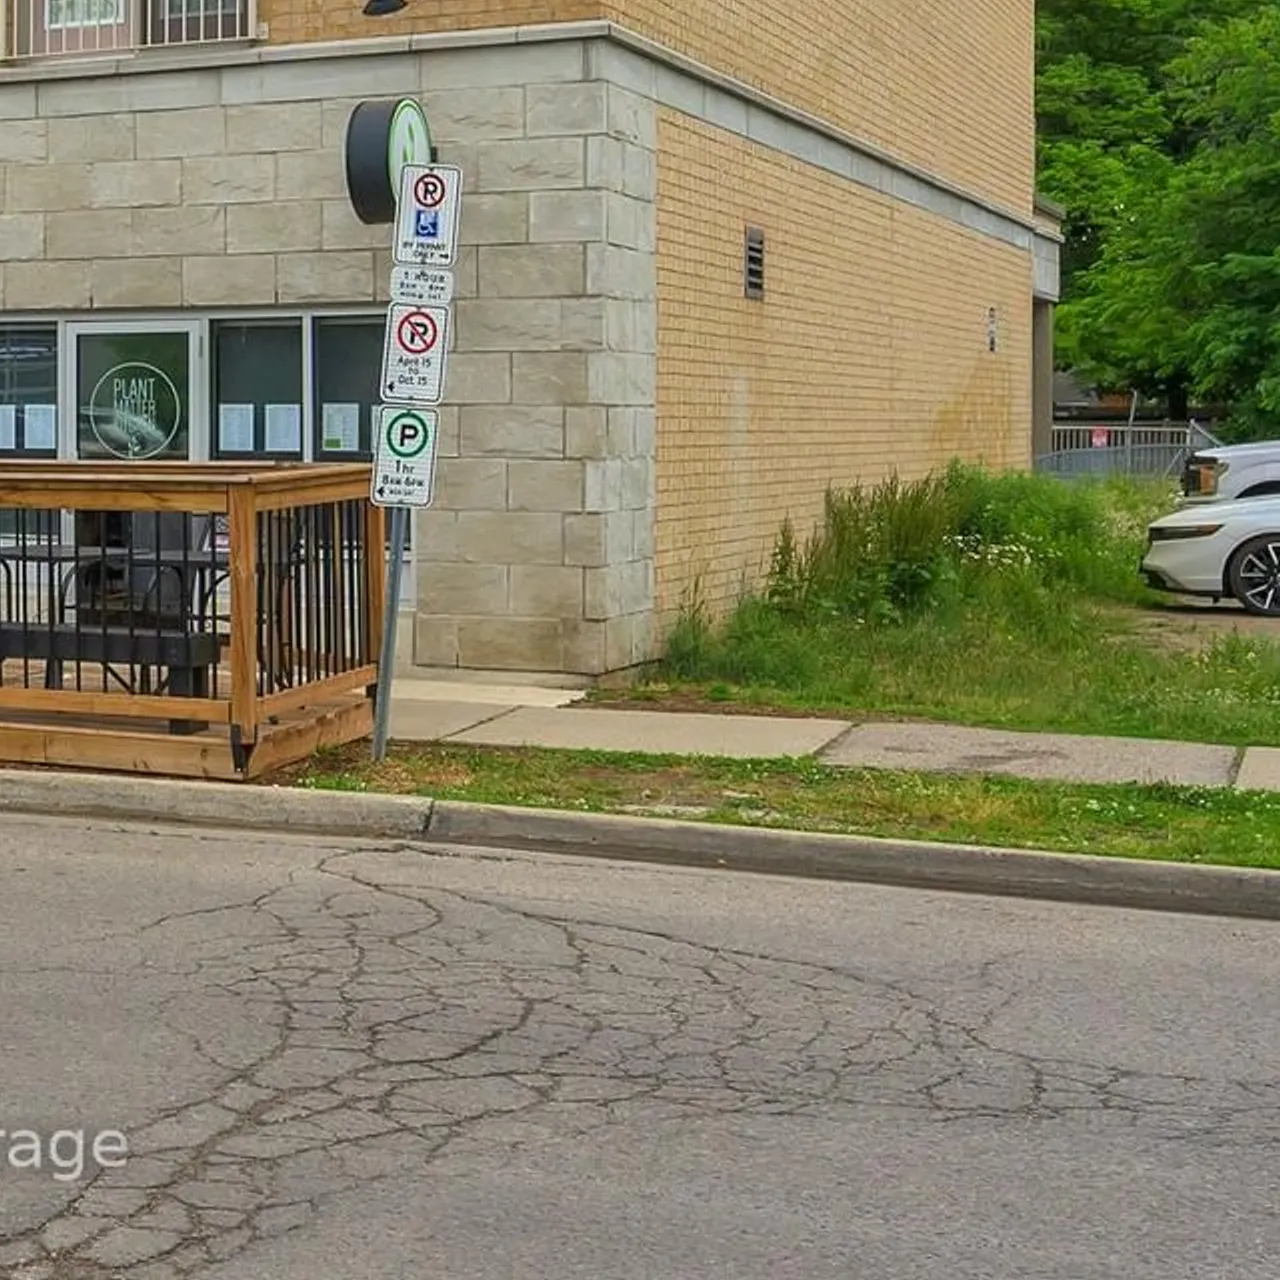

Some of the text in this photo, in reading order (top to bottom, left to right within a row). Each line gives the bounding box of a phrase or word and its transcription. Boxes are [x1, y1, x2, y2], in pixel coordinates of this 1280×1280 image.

[397, 355, 432, 368] April 15
[113, 377, 156, 400] PLANT
